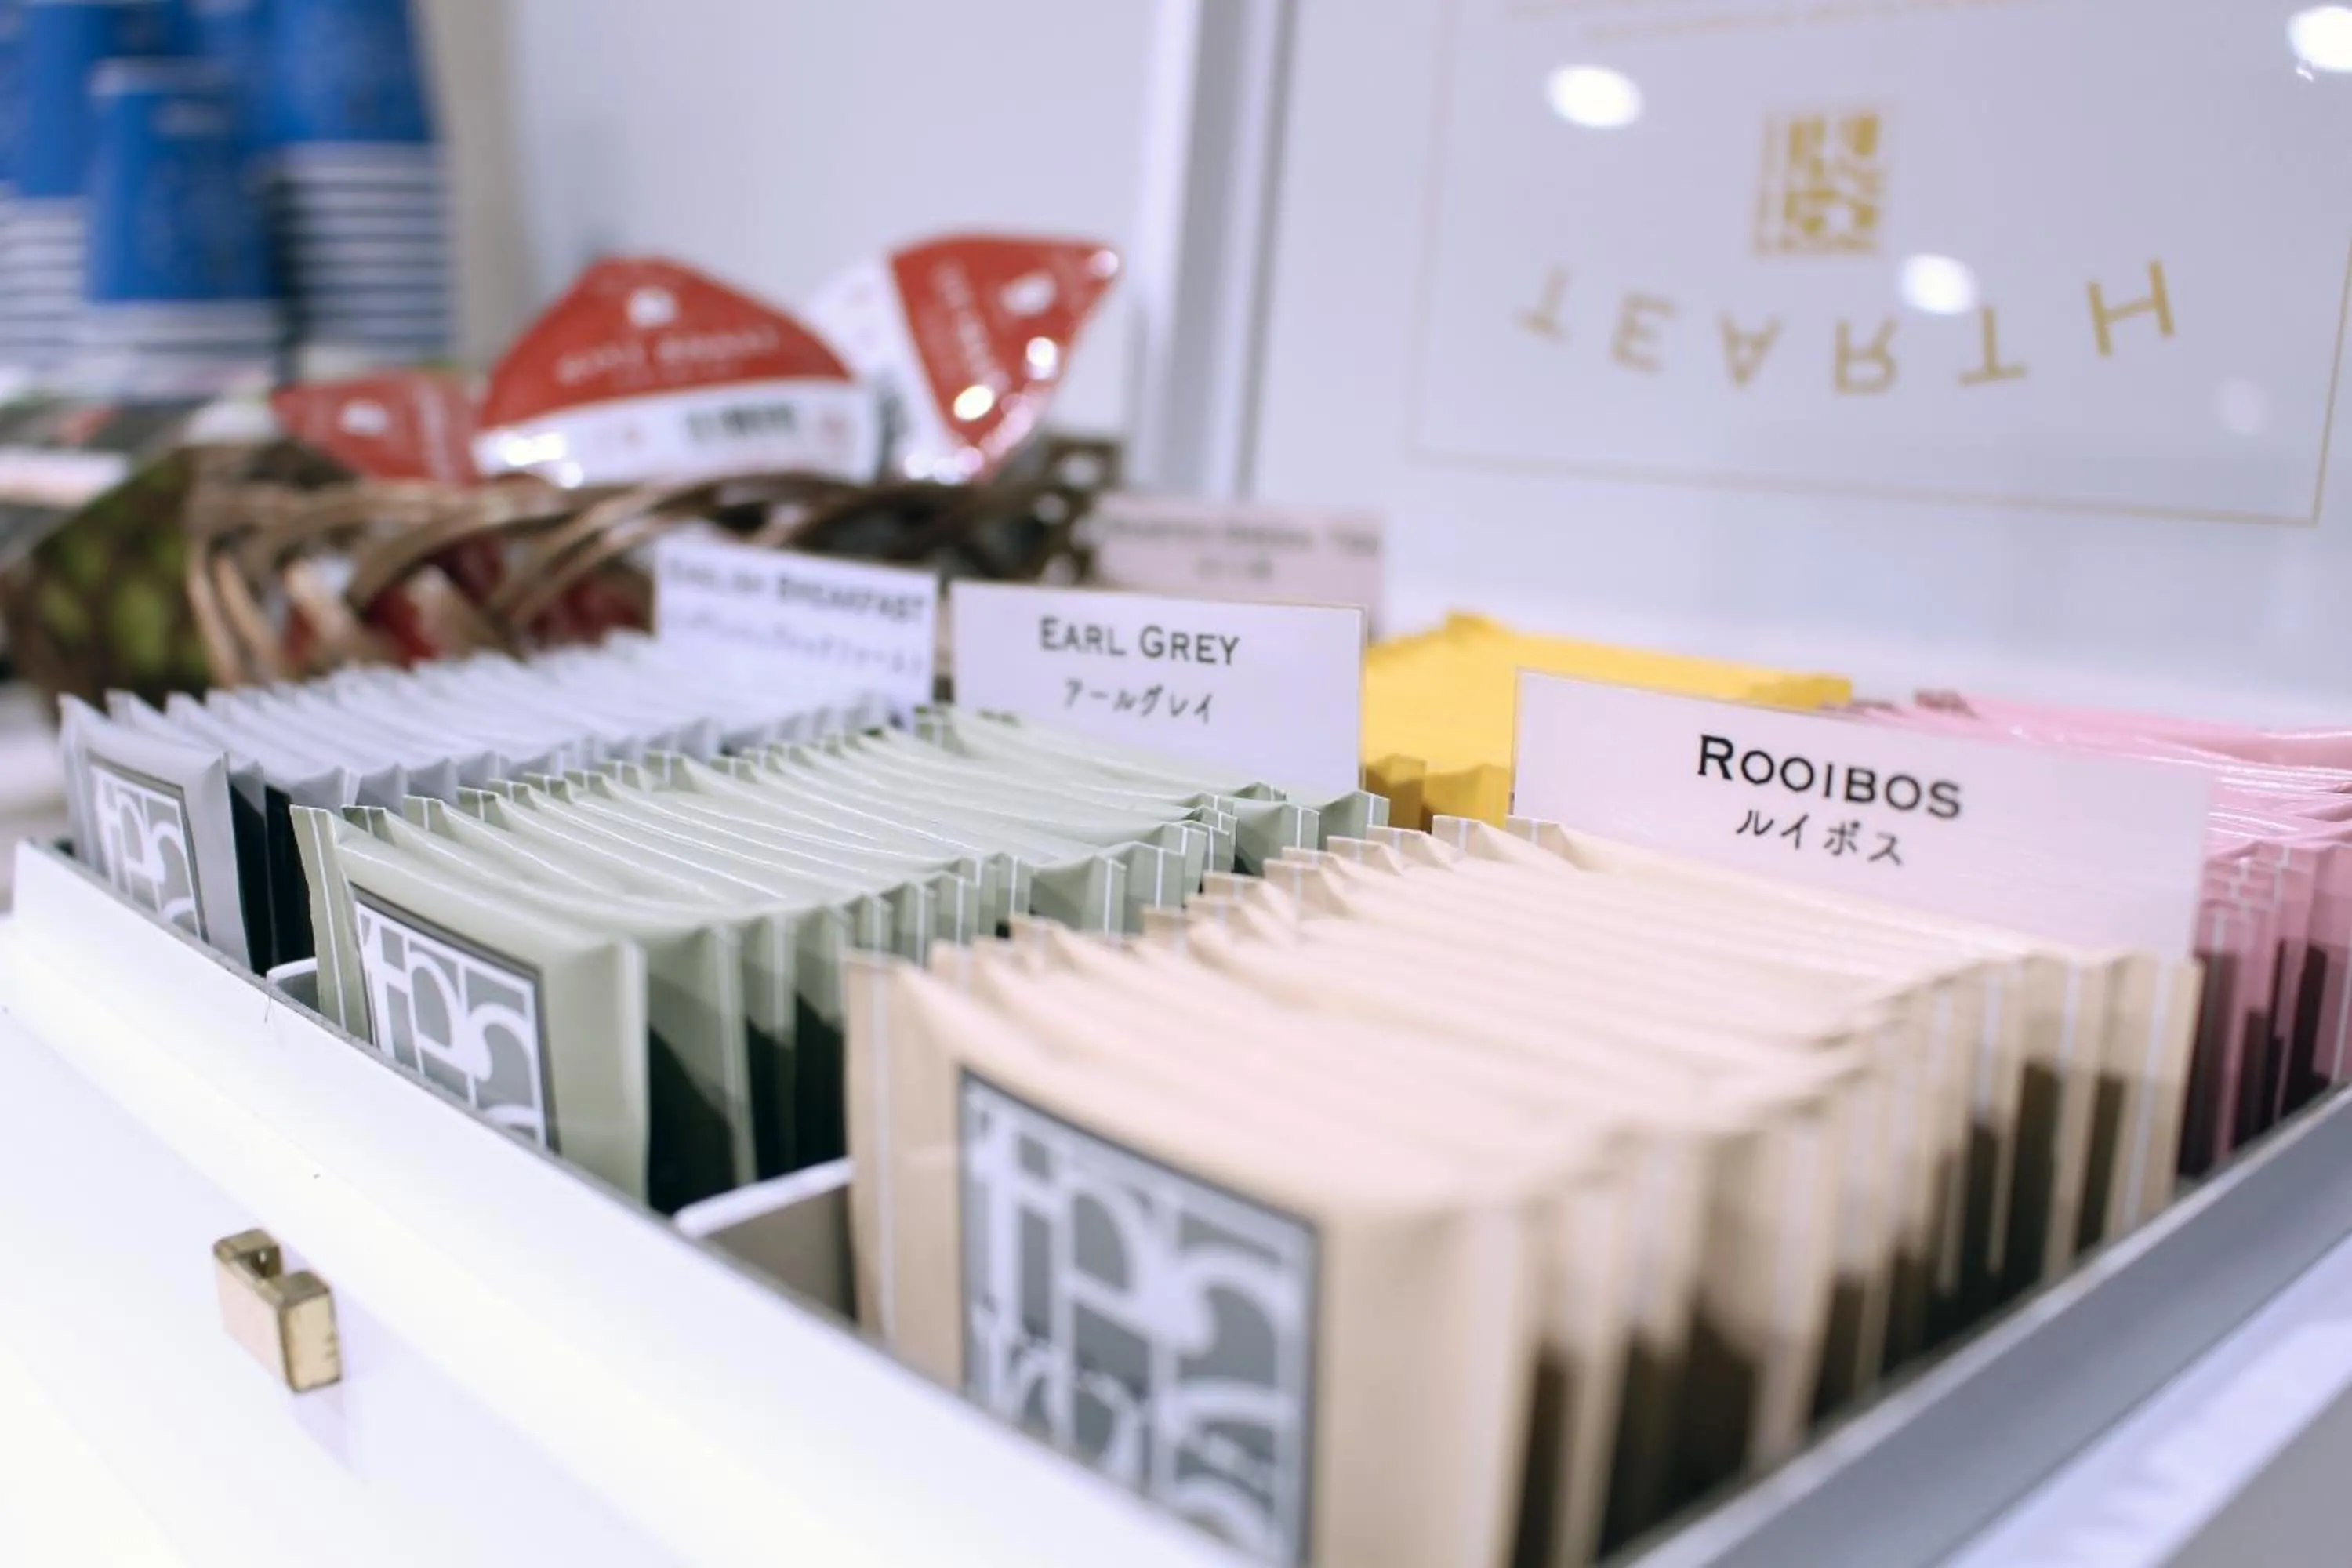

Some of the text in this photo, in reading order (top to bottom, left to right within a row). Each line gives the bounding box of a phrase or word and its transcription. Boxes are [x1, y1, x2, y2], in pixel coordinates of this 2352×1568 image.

[1039, 615, 1240, 666] EARL GREY
[1063, 677, 1213, 726] アールグレイ
[1697, 734, 1962, 819] ROOIBOS
